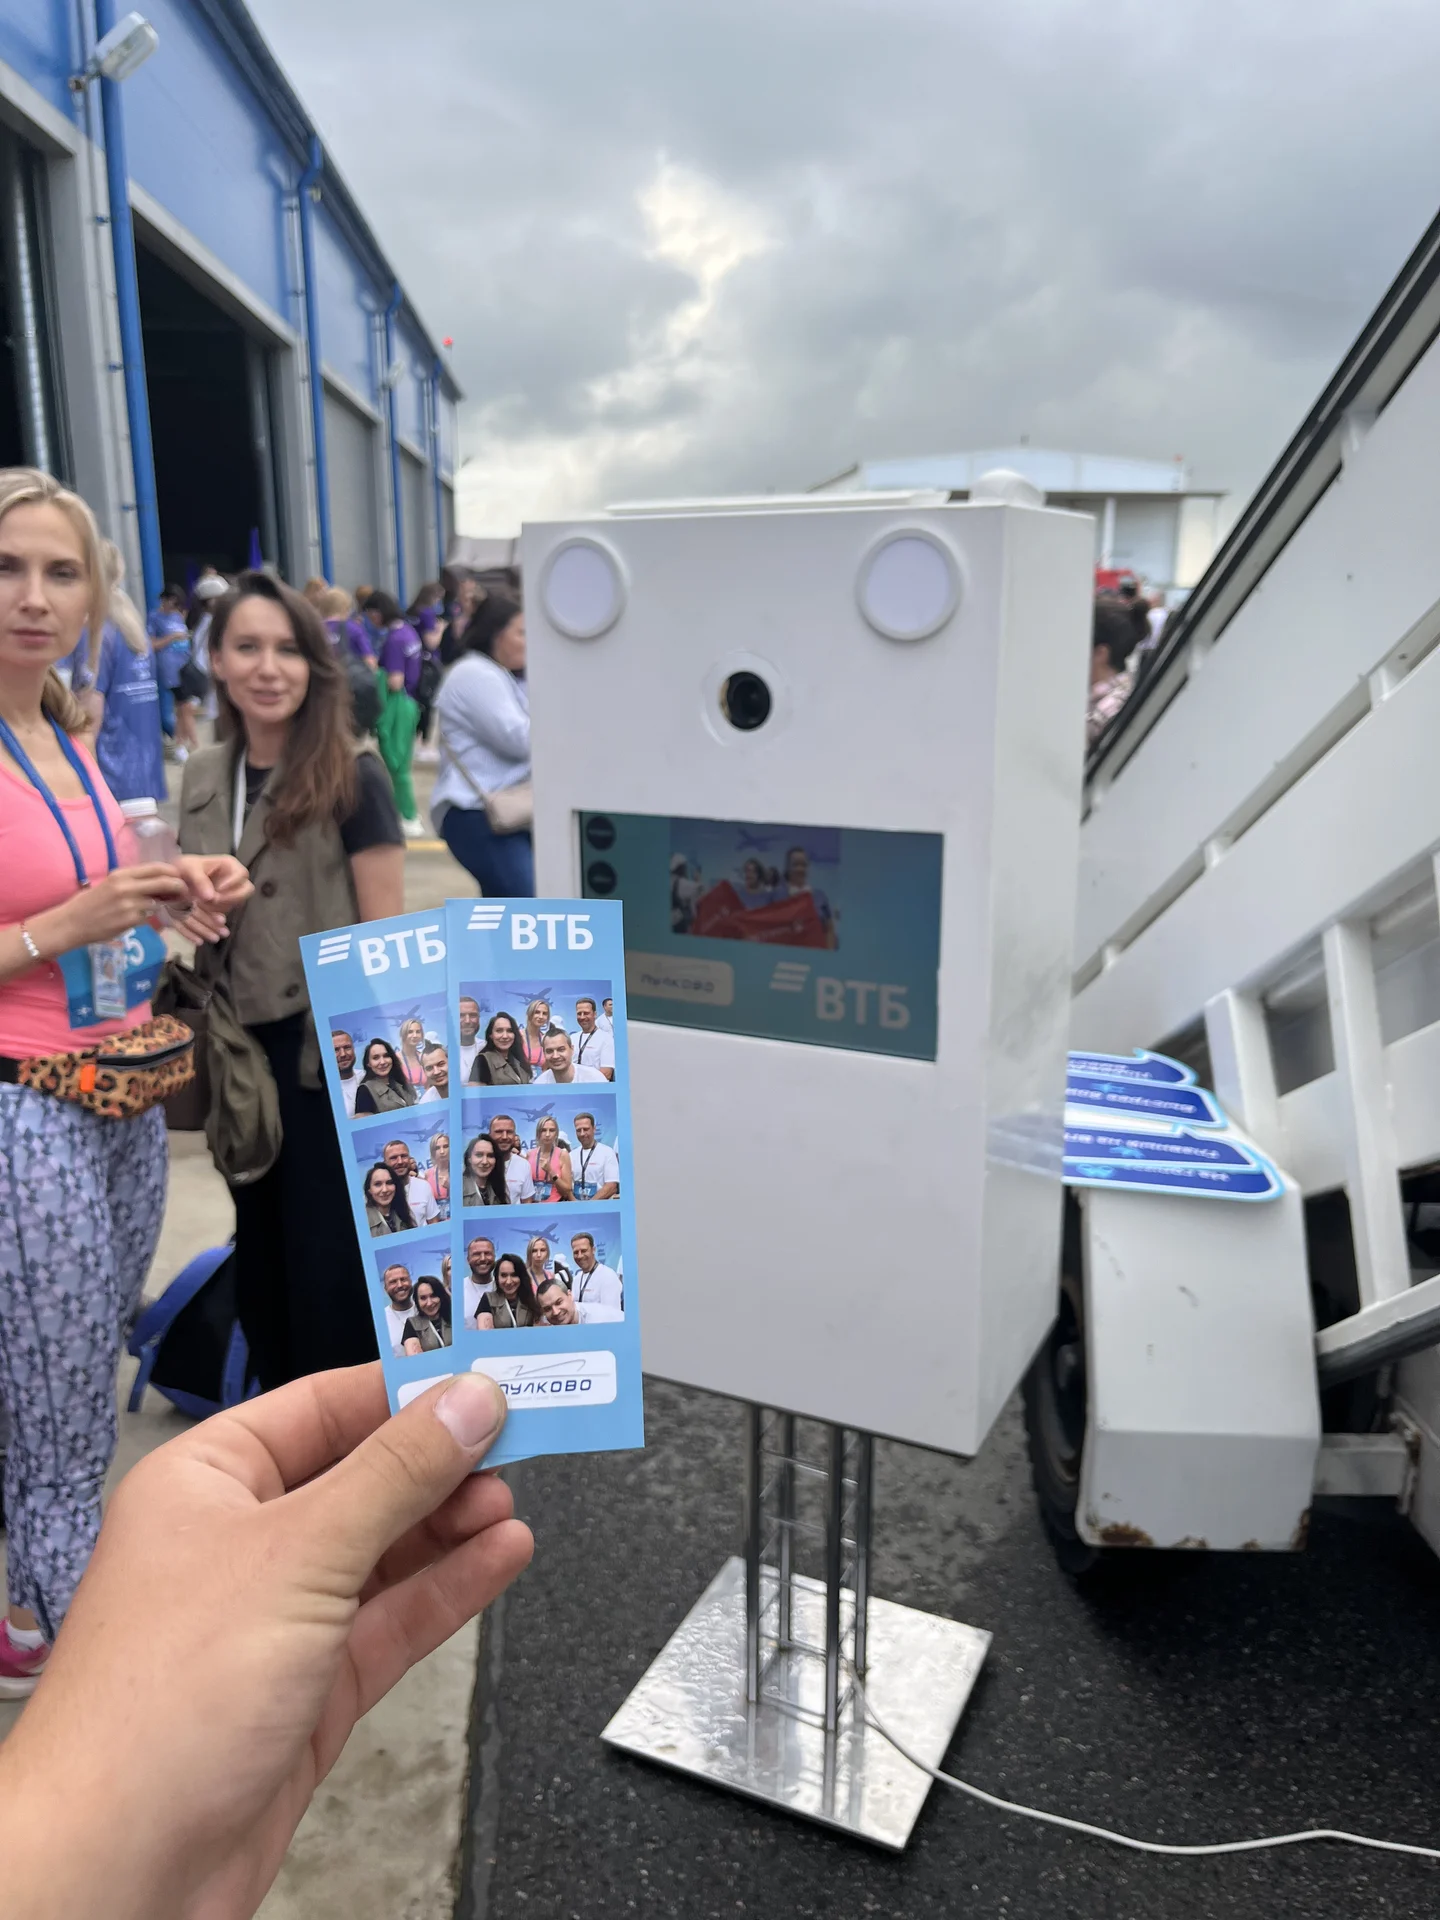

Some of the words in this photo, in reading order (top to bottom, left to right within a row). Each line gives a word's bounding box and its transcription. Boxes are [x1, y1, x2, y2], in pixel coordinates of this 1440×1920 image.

[359, 924, 446, 977] ВТБ
[511, 913, 594, 951] ВТБ
[815, 976, 911, 1030] ВТБ
